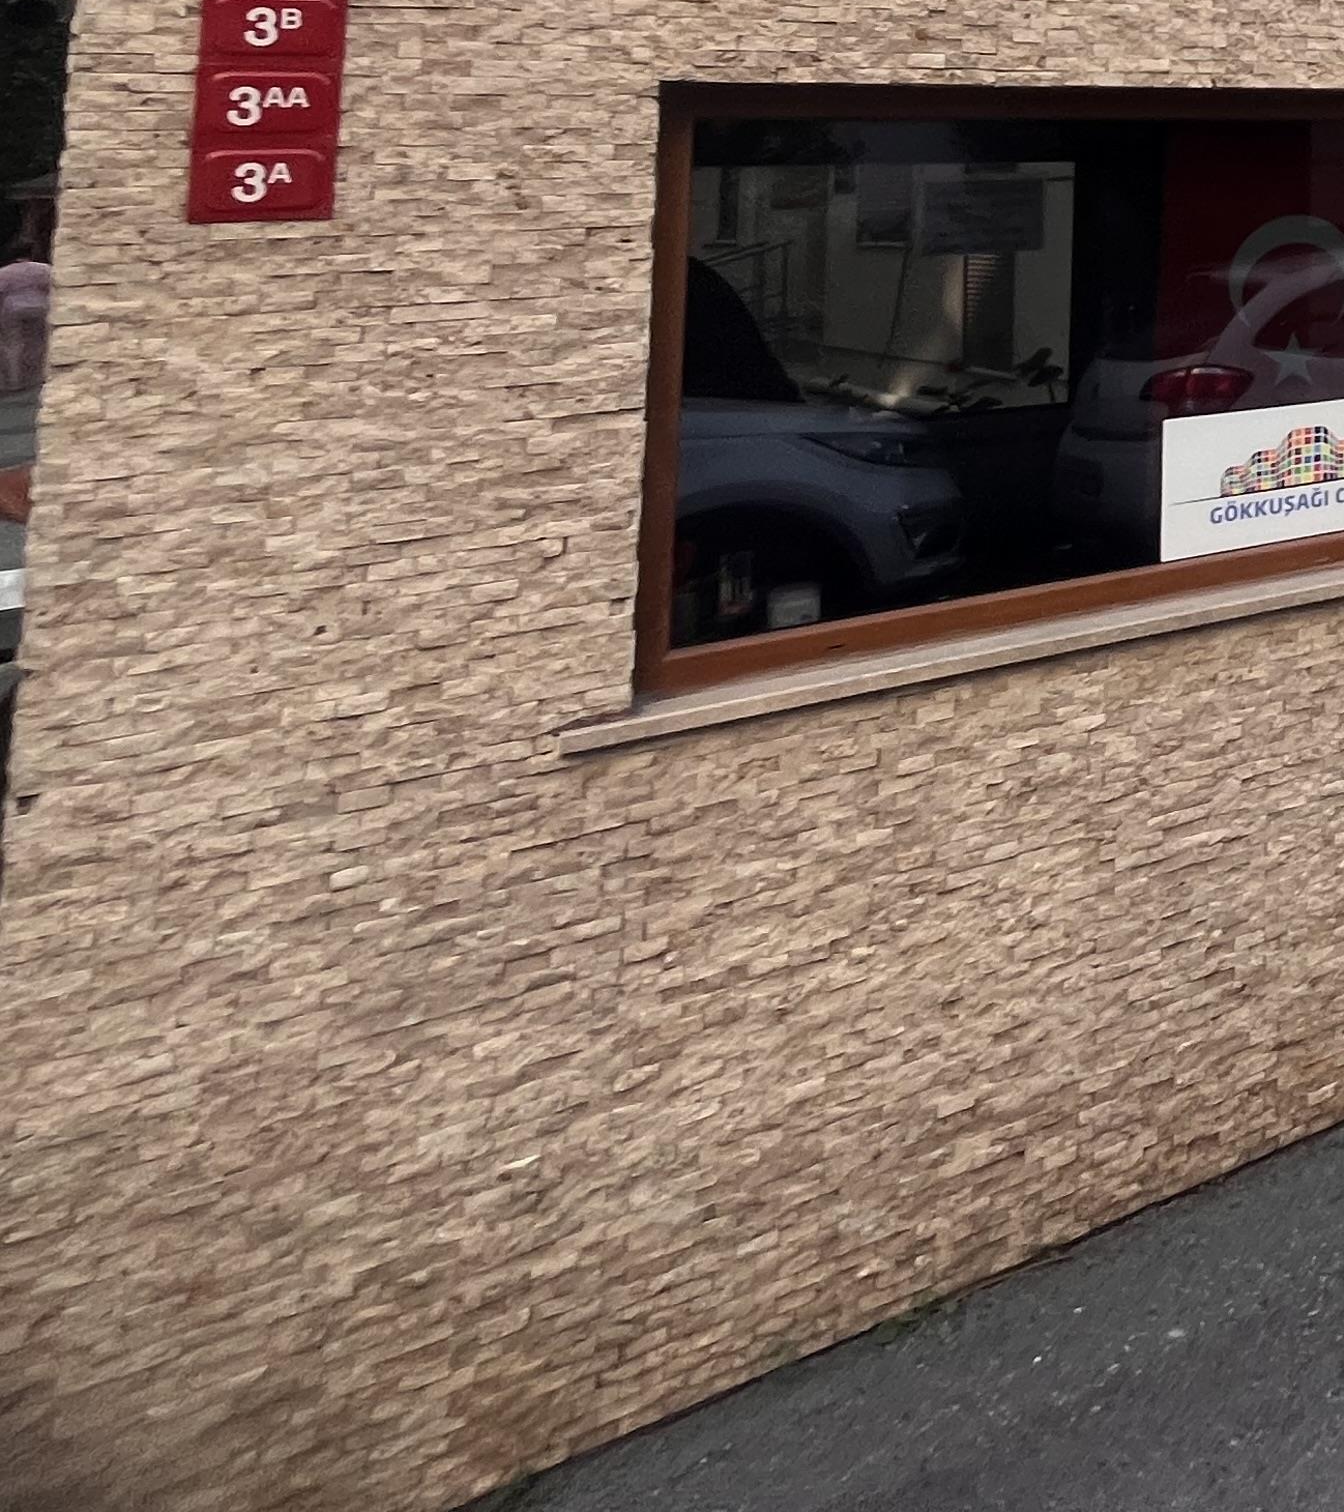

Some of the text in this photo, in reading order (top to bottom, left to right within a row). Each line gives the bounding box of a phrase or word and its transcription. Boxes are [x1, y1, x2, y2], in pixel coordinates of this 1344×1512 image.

[243, 6, 303, 47] 3B
[226, 86, 311, 127] 3AA
[231, 162, 293, 203] 3A
[1209, 487, 1329, 525] GÖKKUŞAĞI
